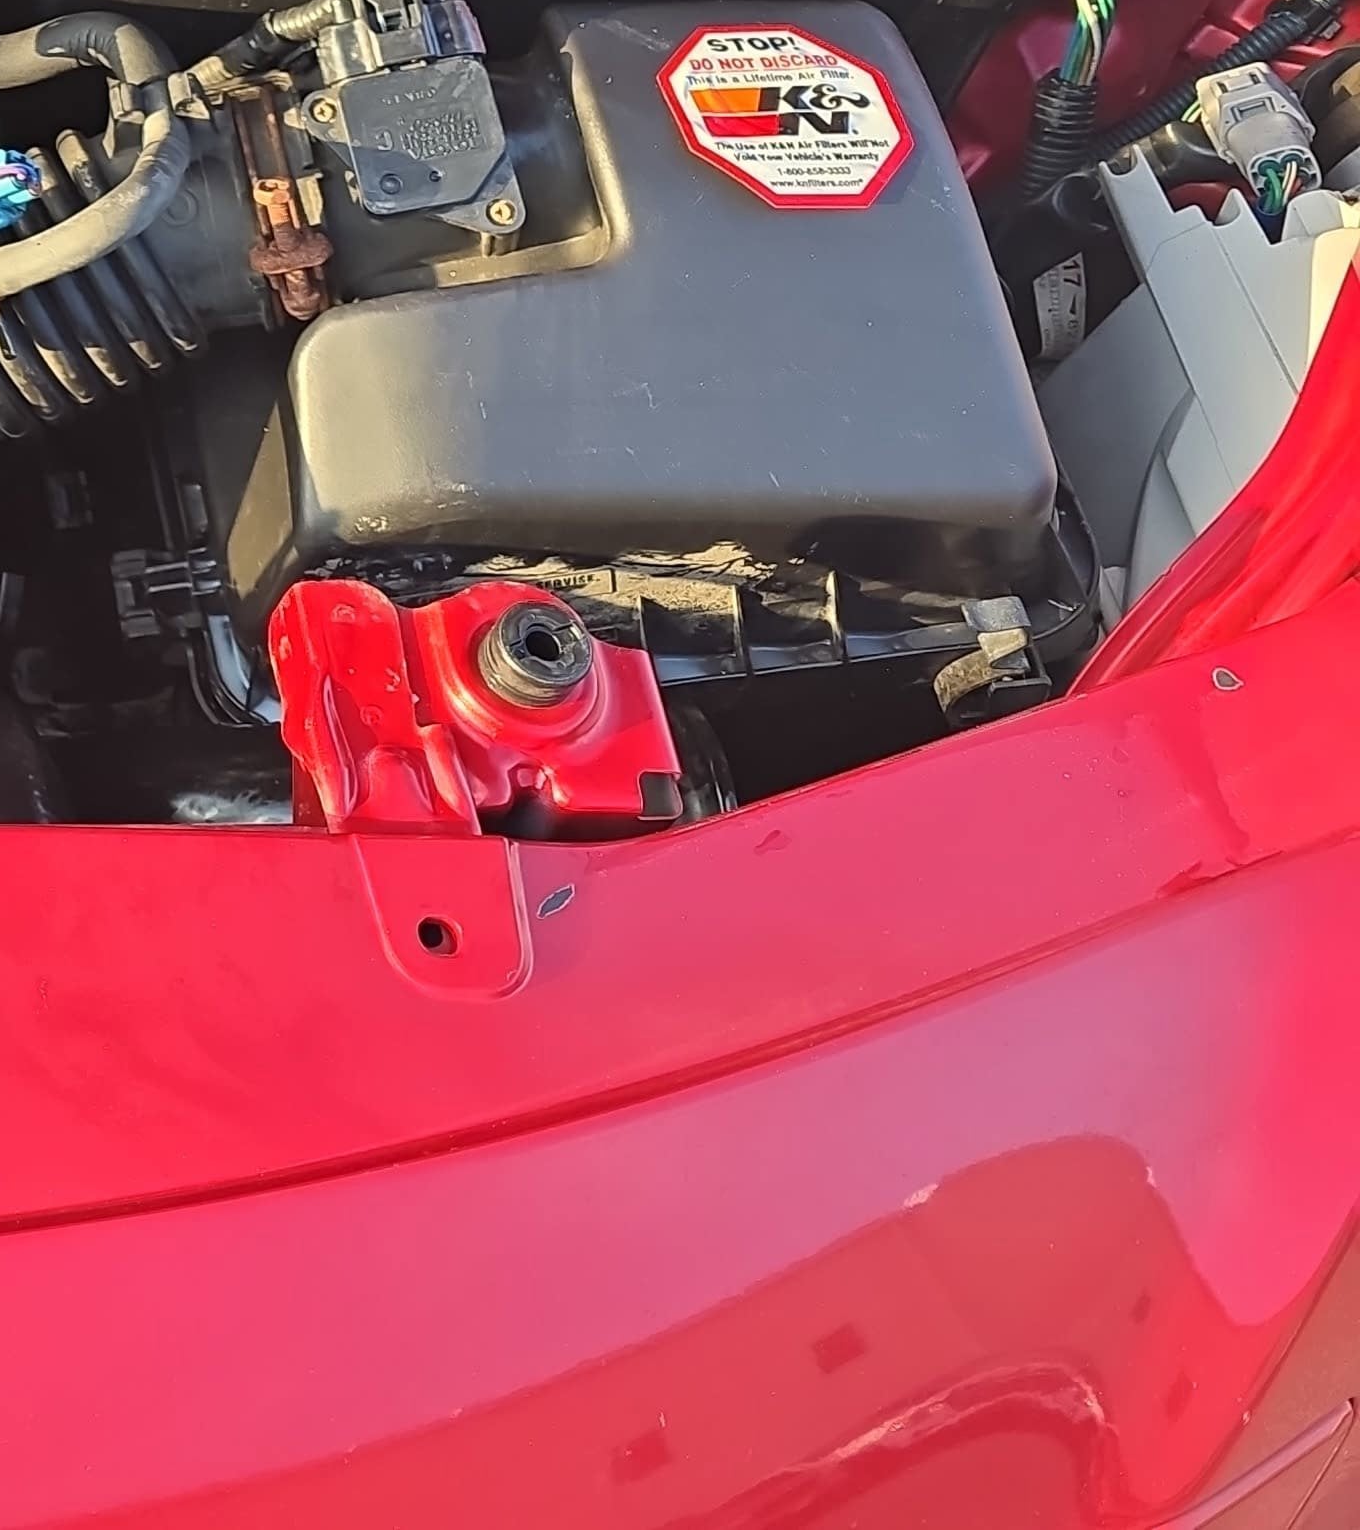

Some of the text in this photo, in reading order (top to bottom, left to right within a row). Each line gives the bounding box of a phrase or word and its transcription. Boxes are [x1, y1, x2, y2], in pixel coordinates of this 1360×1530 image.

[706, 36, 797, 53] STOP!
[690, 54, 838, 71] DO NOT DISCARD
[687, 75, 712, 86] This
[743, 72, 793, 83] Lifetime
[798, 72, 815, 82] Air
[736, 143, 756, 151] Use
